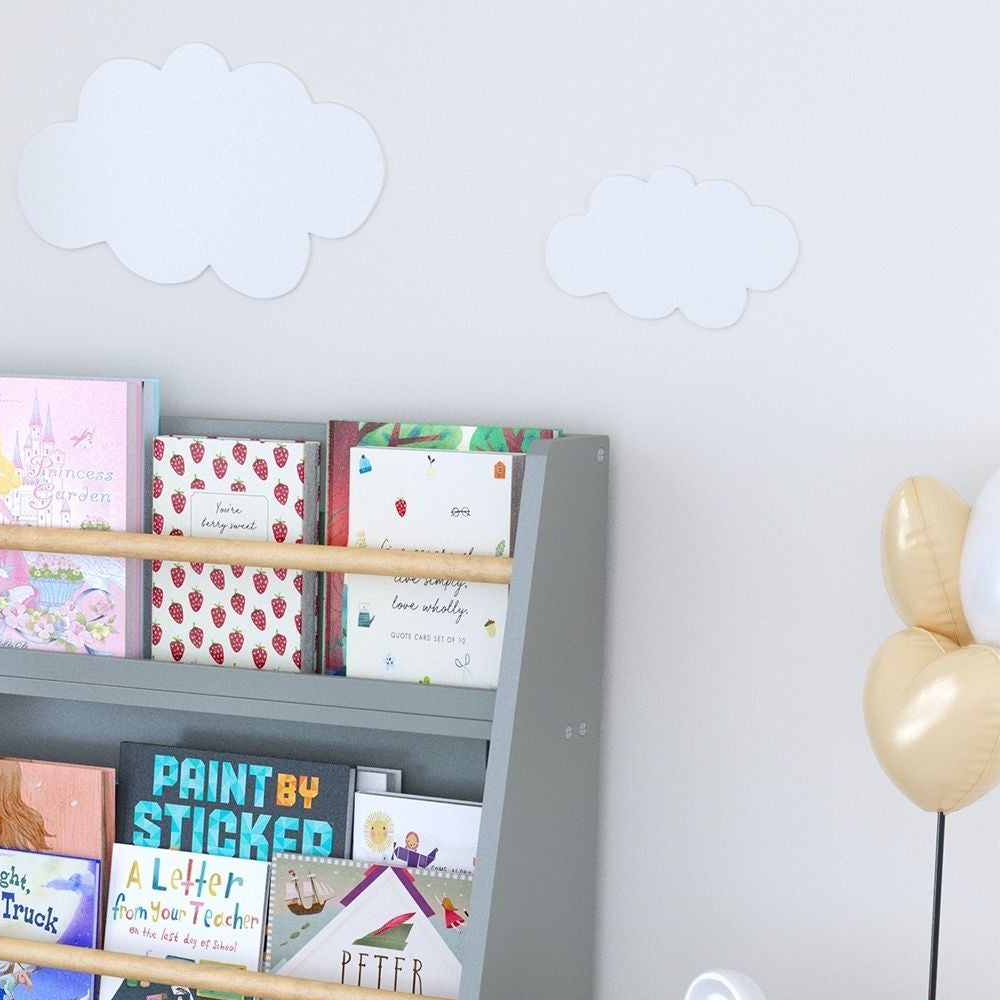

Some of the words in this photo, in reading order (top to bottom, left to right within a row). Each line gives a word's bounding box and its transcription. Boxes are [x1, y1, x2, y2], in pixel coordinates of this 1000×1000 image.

[28, 455, 114, 481] Princess
[29, 483, 111, 510] Garden
[201, 517, 228, 534] berry
[229, 520, 257, 531] sweet
[392, 595, 419, 611] love
[422, 598, 469, 624] wholly.
[390, 631, 412, 640] QUOTE
[414, 634, 431, 642] CARD
[152, 754, 273, 808] PAINT
[276, 773, 320, 809] BY
[126, 860, 142, 890] A
[152, 857, 244, 899] Letter
[1, 891, 59, 934] Truck
[112, 892, 148, 921] from
[189, 900, 259, 930] Teacher
[142, 926, 157, 940] the
[160, 928, 179, 943] last
[183, 934, 198, 949] day
[200, 940, 210, 949] of
